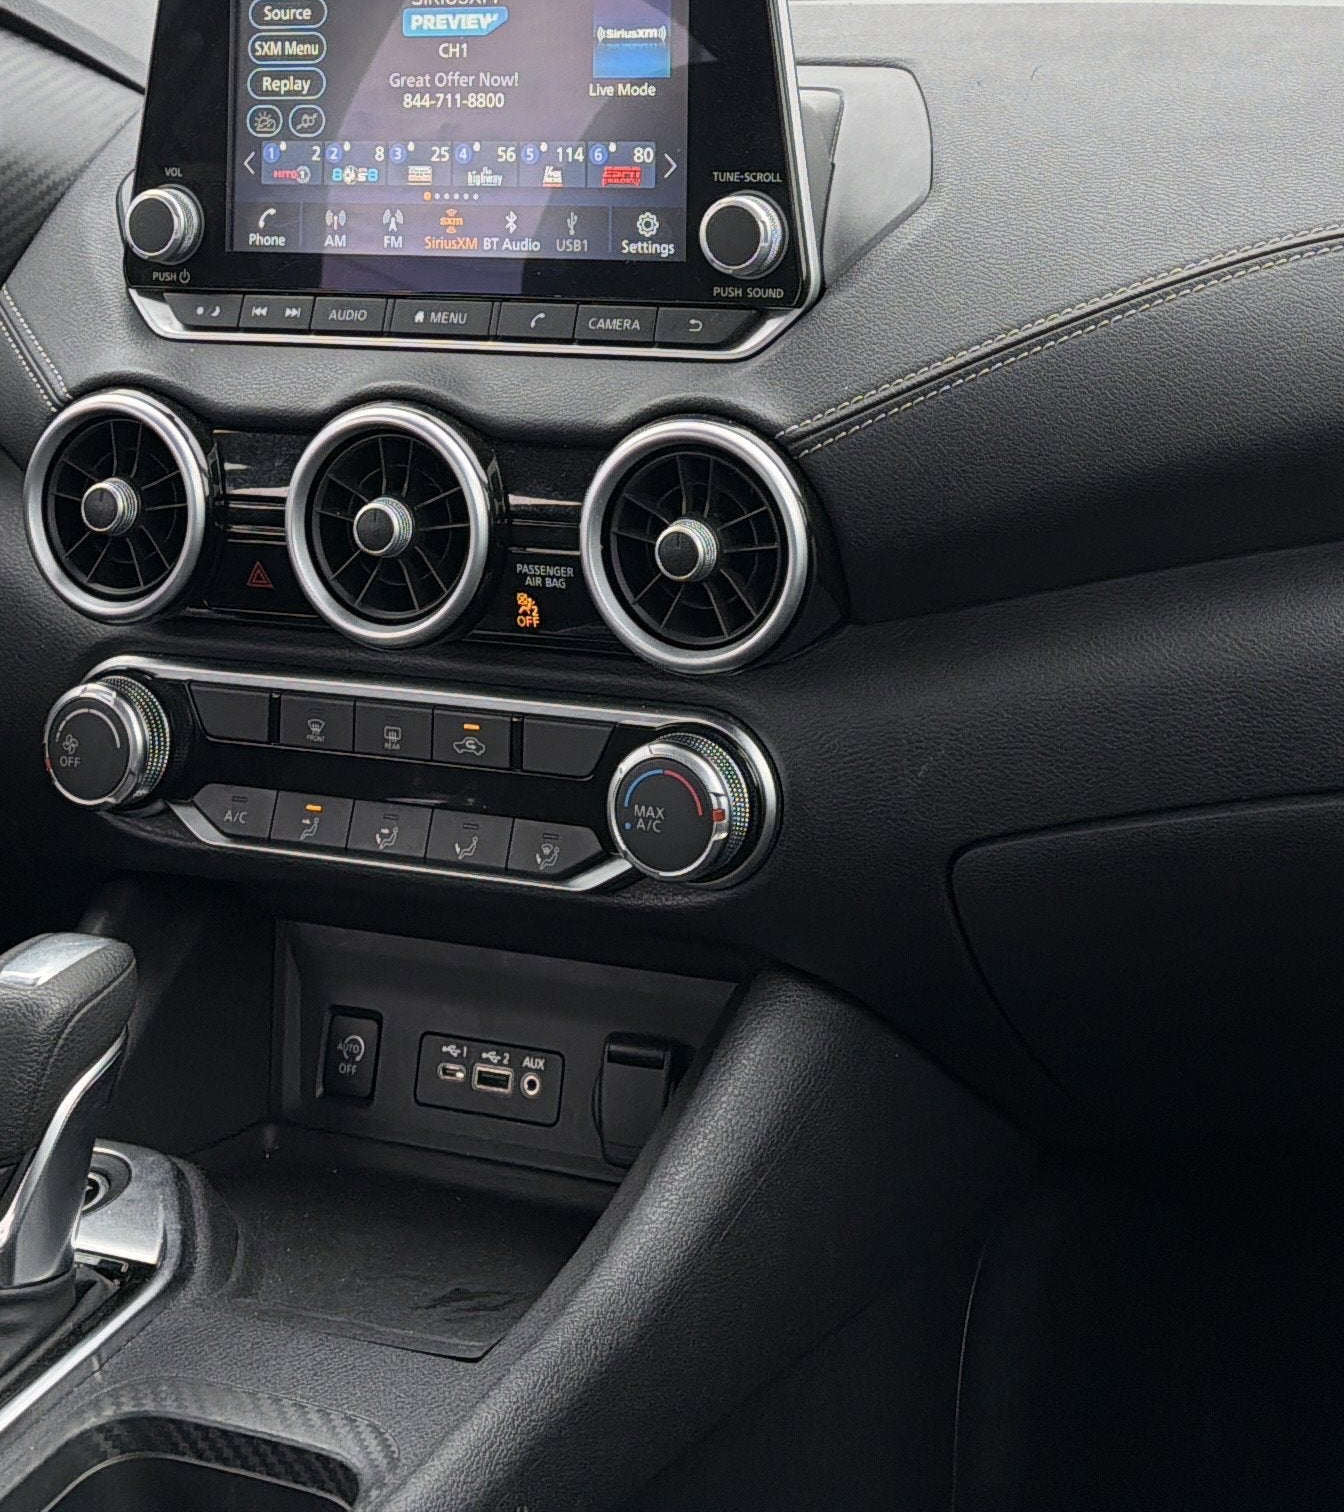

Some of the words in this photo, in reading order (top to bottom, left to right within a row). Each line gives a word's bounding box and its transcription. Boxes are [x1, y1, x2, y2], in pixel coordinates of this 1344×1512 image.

[263, 5, 312, 21] Source
[411, 13, 498, 31] PREVIEW
[254, 41, 282, 56] SXM
[285, 41, 319, 56] Menu
[439, 43, 467, 58] CH1
[262, 77, 311, 94] Replay
[389, 73, 431, 88] Great
[435, 72, 475, 88] Offer
[479, 72, 519, 87] Now!
[589, 84, 614, 97] Live
[618, 83, 657, 97] Mode
[403, 93, 505, 109] 844-711-8800
[311, 145, 321, 161] 2
[374, 145, 385, 162] 8
[430, 145, 450, 162] 25
[497, 146, 517, 162] 56
[556, 146, 585, 163] 114
[633, 147, 654, 163] 80
[164, 167, 183, 178] VOL
[248, 233, 286, 247] Phone
[324, 235, 346, 248] AM
[383, 236, 403, 249] FM
[424, 237, 478, 250] SiriusXM
[483, 238, 500, 250] BT
[502, 238, 541, 252] Audio
[556, 240, 588, 252] USB1
[621, 240, 675, 258] Settings
[152, 271, 177, 282] PUSH
[713, 286, 743, 298] PUSH
[746, 287, 784, 299] SOUND
[328, 308, 368, 321] AUDIO
[430, 311, 468, 325] MENU
[588, 317, 641, 331] CAMERA
[516, 563, 574, 578] PASSENGER
[525, 576, 542, 588] AIR
[545, 577, 566, 589] BAG
[516, 615, 540, 628] OFF
[306, 734, 325, 743] FRONT
[59, 755, 81, 768] OFF
[223, 809, 248, 824] A/C
[634, 803, 665, 820] MAX
[636, 818, 662, 833] A/C
[337, 1043, 360, 1055] AUTO
[502, 1052, 510, 1064] 2
[522, 1056, 546, 1071] AUX
[338, 1063, 357, 1076] OFF
